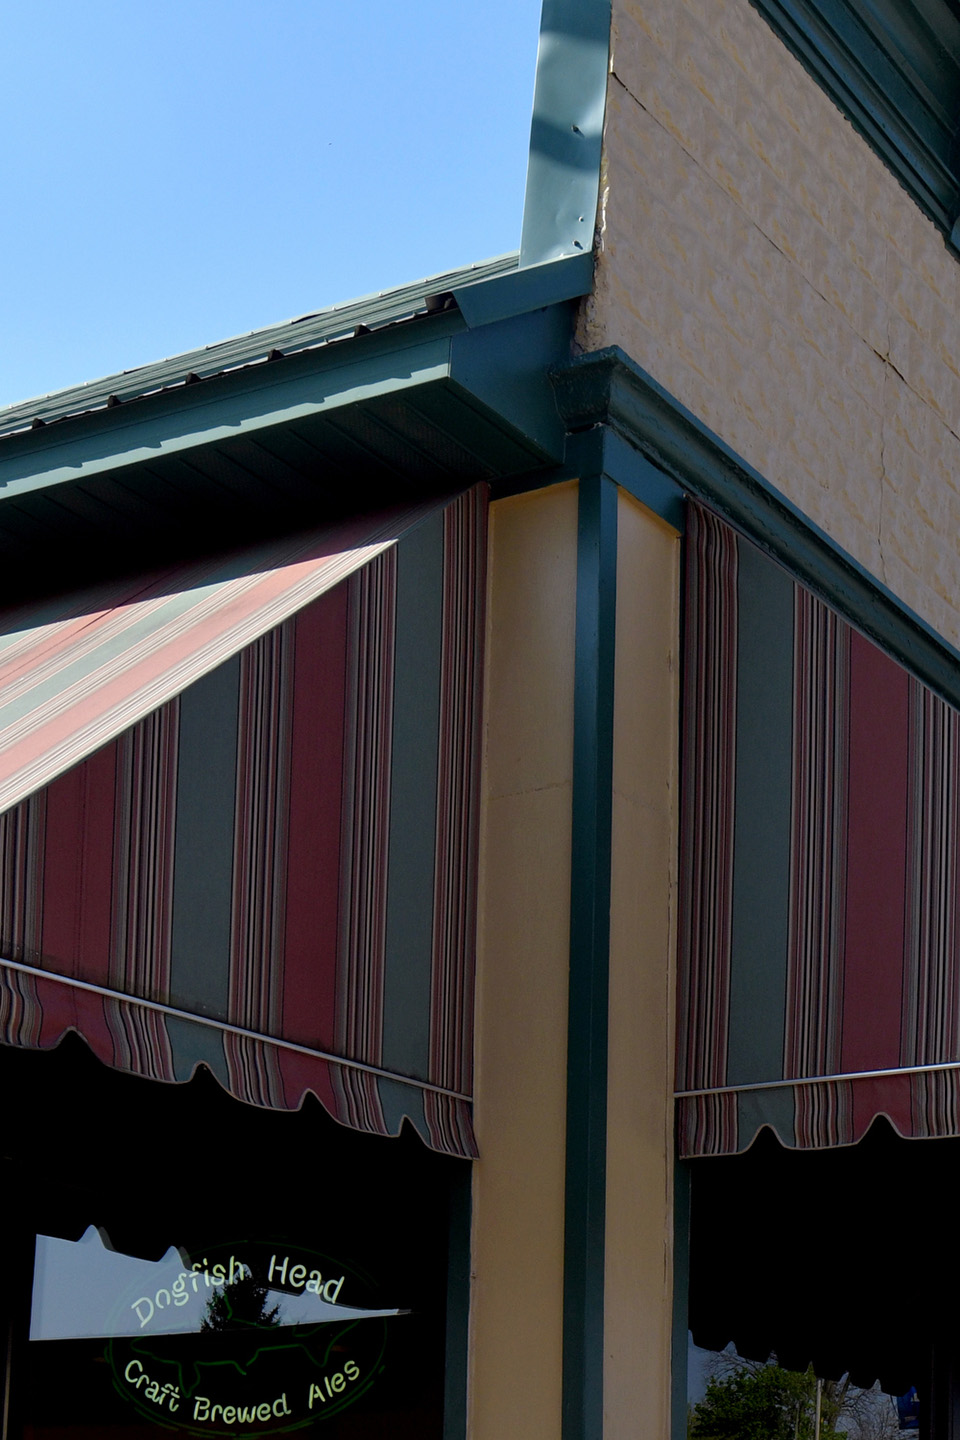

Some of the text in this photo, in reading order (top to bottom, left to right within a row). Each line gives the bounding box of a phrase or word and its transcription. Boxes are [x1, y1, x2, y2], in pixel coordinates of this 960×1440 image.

[131, 1254, 345, 1329] Dogfish Head
[124, 1359, 361, 1425] Craft Brewed Ales
